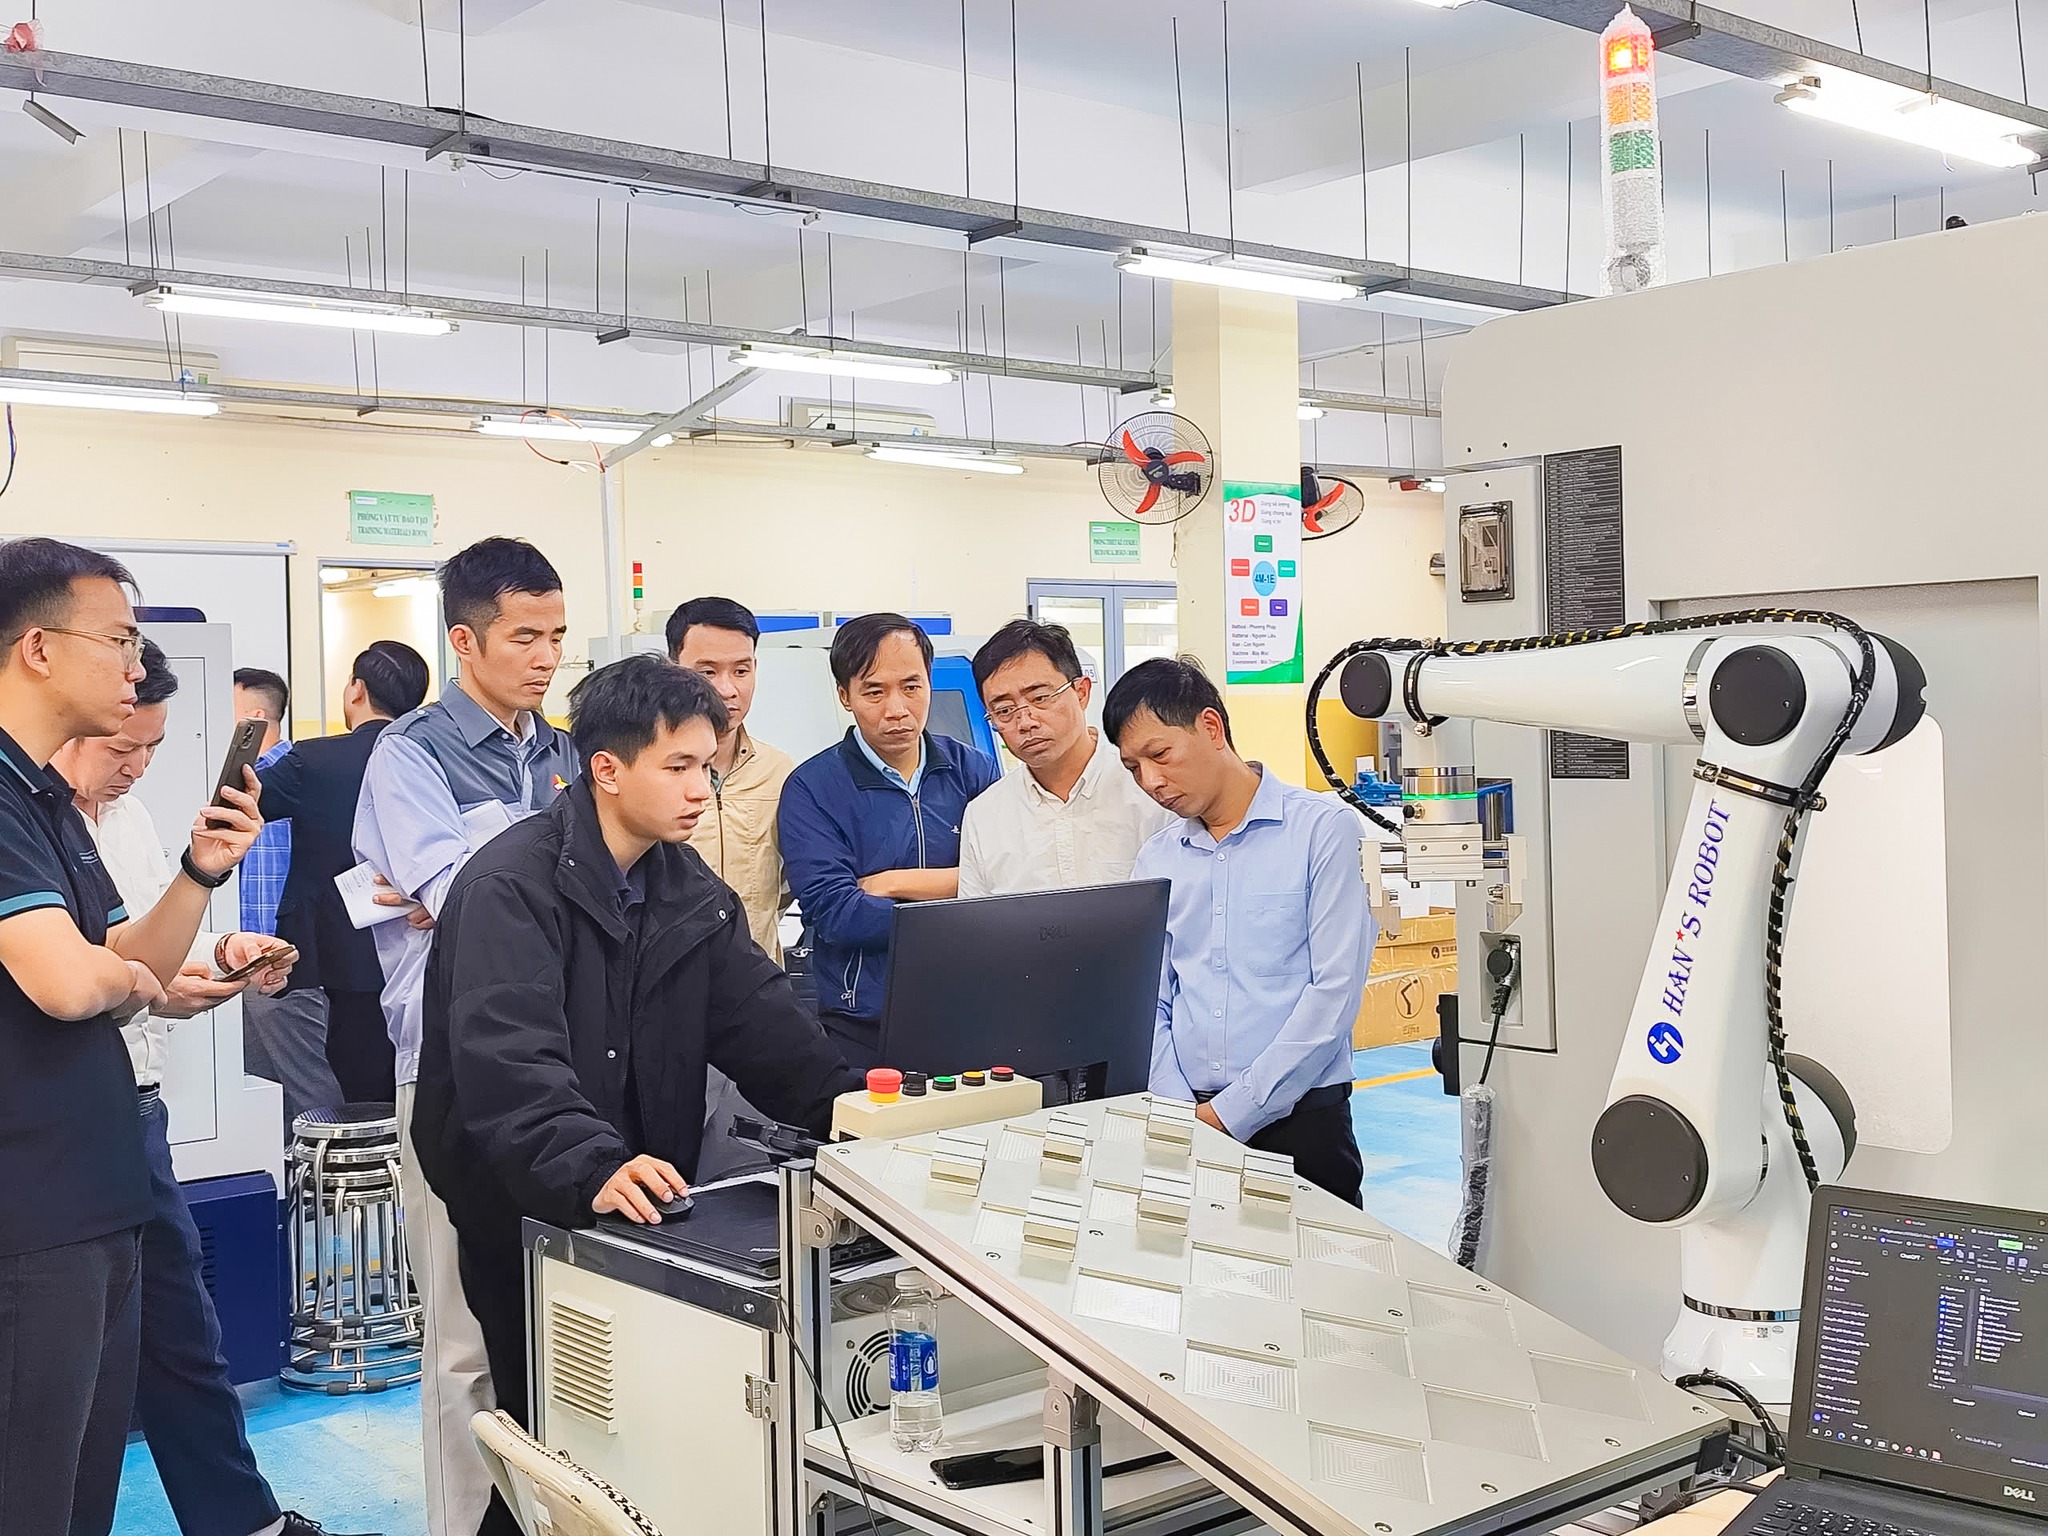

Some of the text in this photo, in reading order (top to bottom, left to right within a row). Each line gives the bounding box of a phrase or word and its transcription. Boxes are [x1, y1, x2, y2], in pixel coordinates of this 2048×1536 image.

[1229, 498, 1256, 523] 3D
[1255, 573, 1276, 584] 4M-1E
[1688, 798, 1731, 909] ROBOT
[2003, 1485, 2036, 1502] DELL
